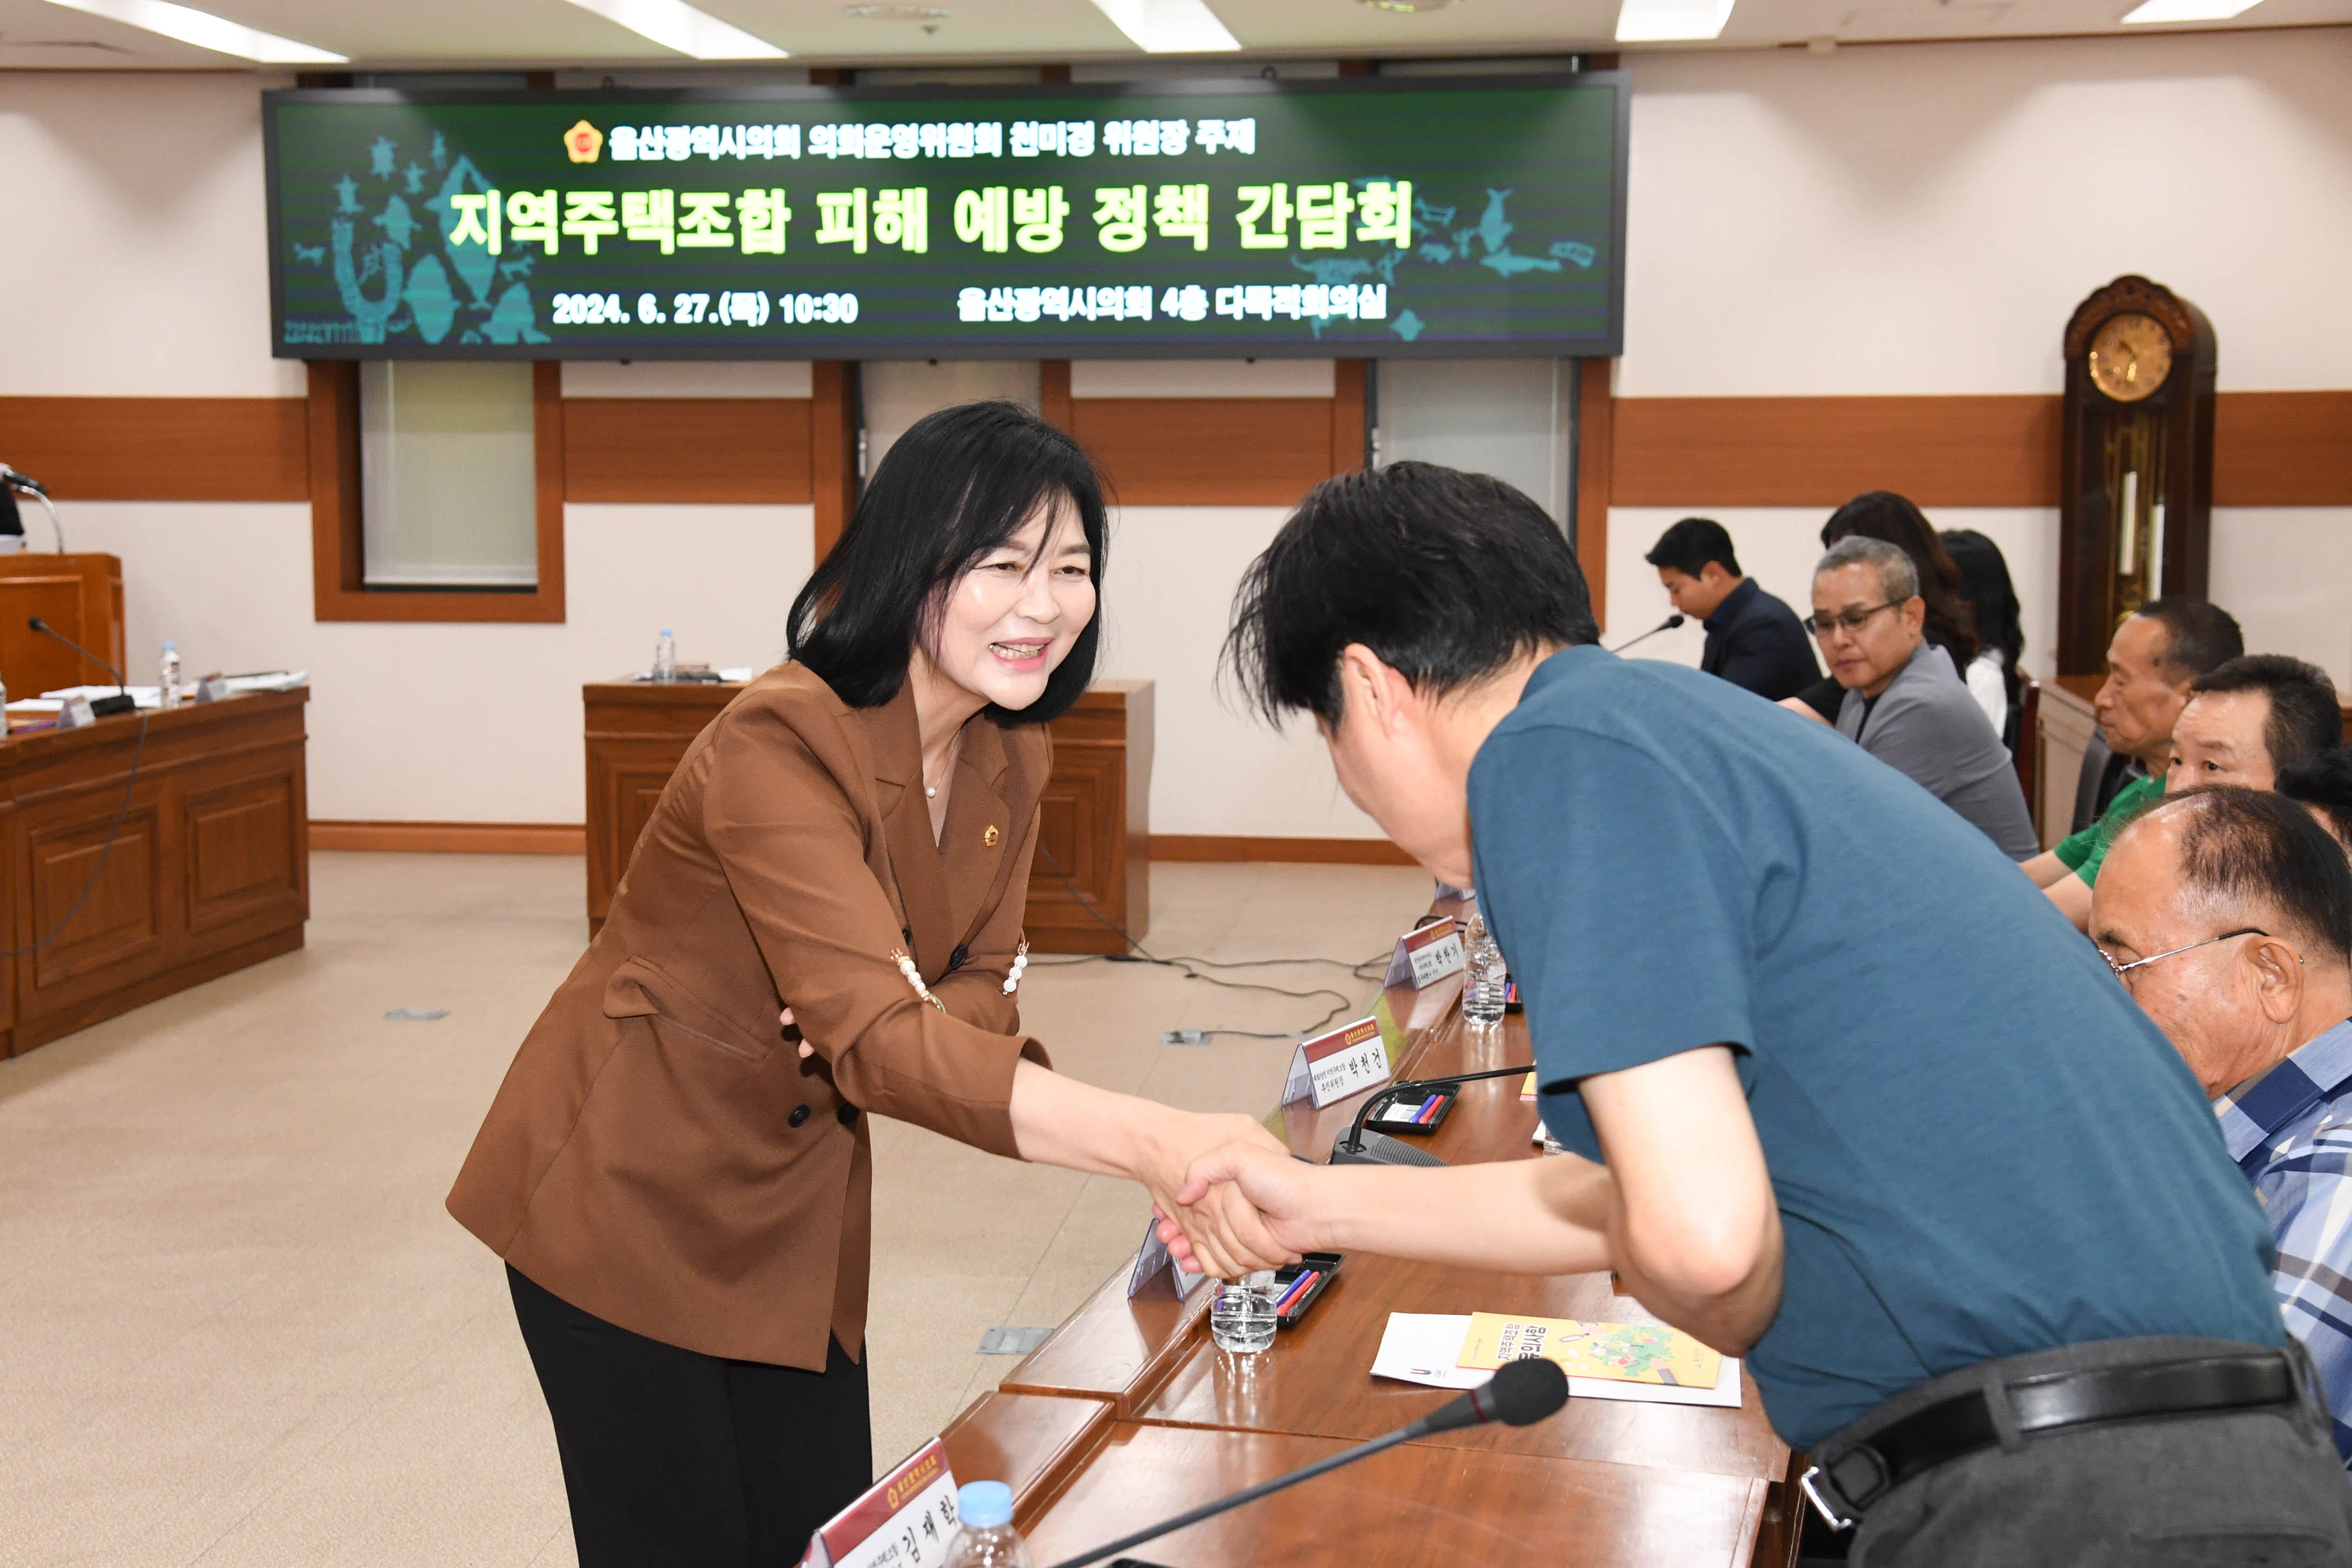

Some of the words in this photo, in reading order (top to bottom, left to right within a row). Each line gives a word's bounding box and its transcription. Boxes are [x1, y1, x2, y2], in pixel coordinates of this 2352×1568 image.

[609, 124, 801, 161] 울산광역시의회
[808, 122, 1002, 159] 의회운영위원회
[1010, 121, 1094, 157] 천미경
[1103, 119, 1190, 156] 위원장
[1195, 118, 1255, 154] 주재
[449, 187, 792, 256] 지역주택조합
[815, 187, 928, 255] 피해
[954, 185, 1070, 254] 예방
[1092, 183, 1209, 253] 정책
[1235, 180, 1412, 250] 간담회
[553, 294, 630, 324] 2024.
[638, 294, 666, 324] 6.
[674, 291, 770, 327] 27.(목)
[779, 293, 858, 323] 10:30
[957, 286, 1152, 322] 울산광역시의회
[1160, 285, 1209, 321] 4층
[1215, 284, 1386, 320] 다목적회의실
[1498, 1324, 1520, 1361] 지역주택조합
